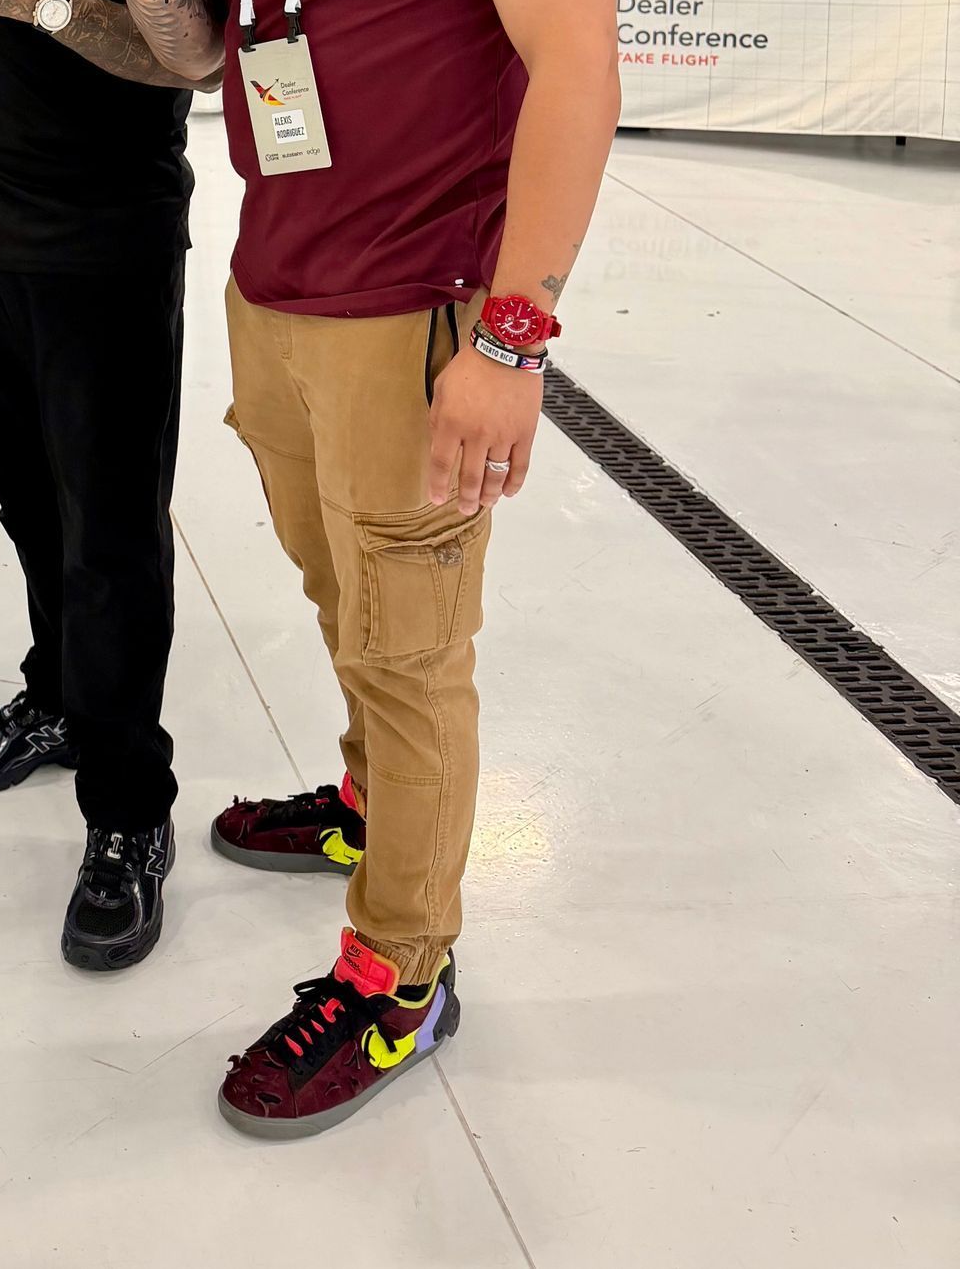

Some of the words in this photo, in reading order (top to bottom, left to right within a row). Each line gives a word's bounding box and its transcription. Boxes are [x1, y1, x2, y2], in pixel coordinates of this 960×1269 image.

[618, 23, 769, 49] Conference
[662, 54, 720, 66] FLIGHT
[281, 81, 296, 90] Dealer
[282, 87, 310, 96] Conference
[274, 115, 292, 126] ALEXIS
[277, 127, 305, 138] RODRIGUEZ
[480, 341, 499, 357] PUERTO
[500, 352, 514, 363] RICO
